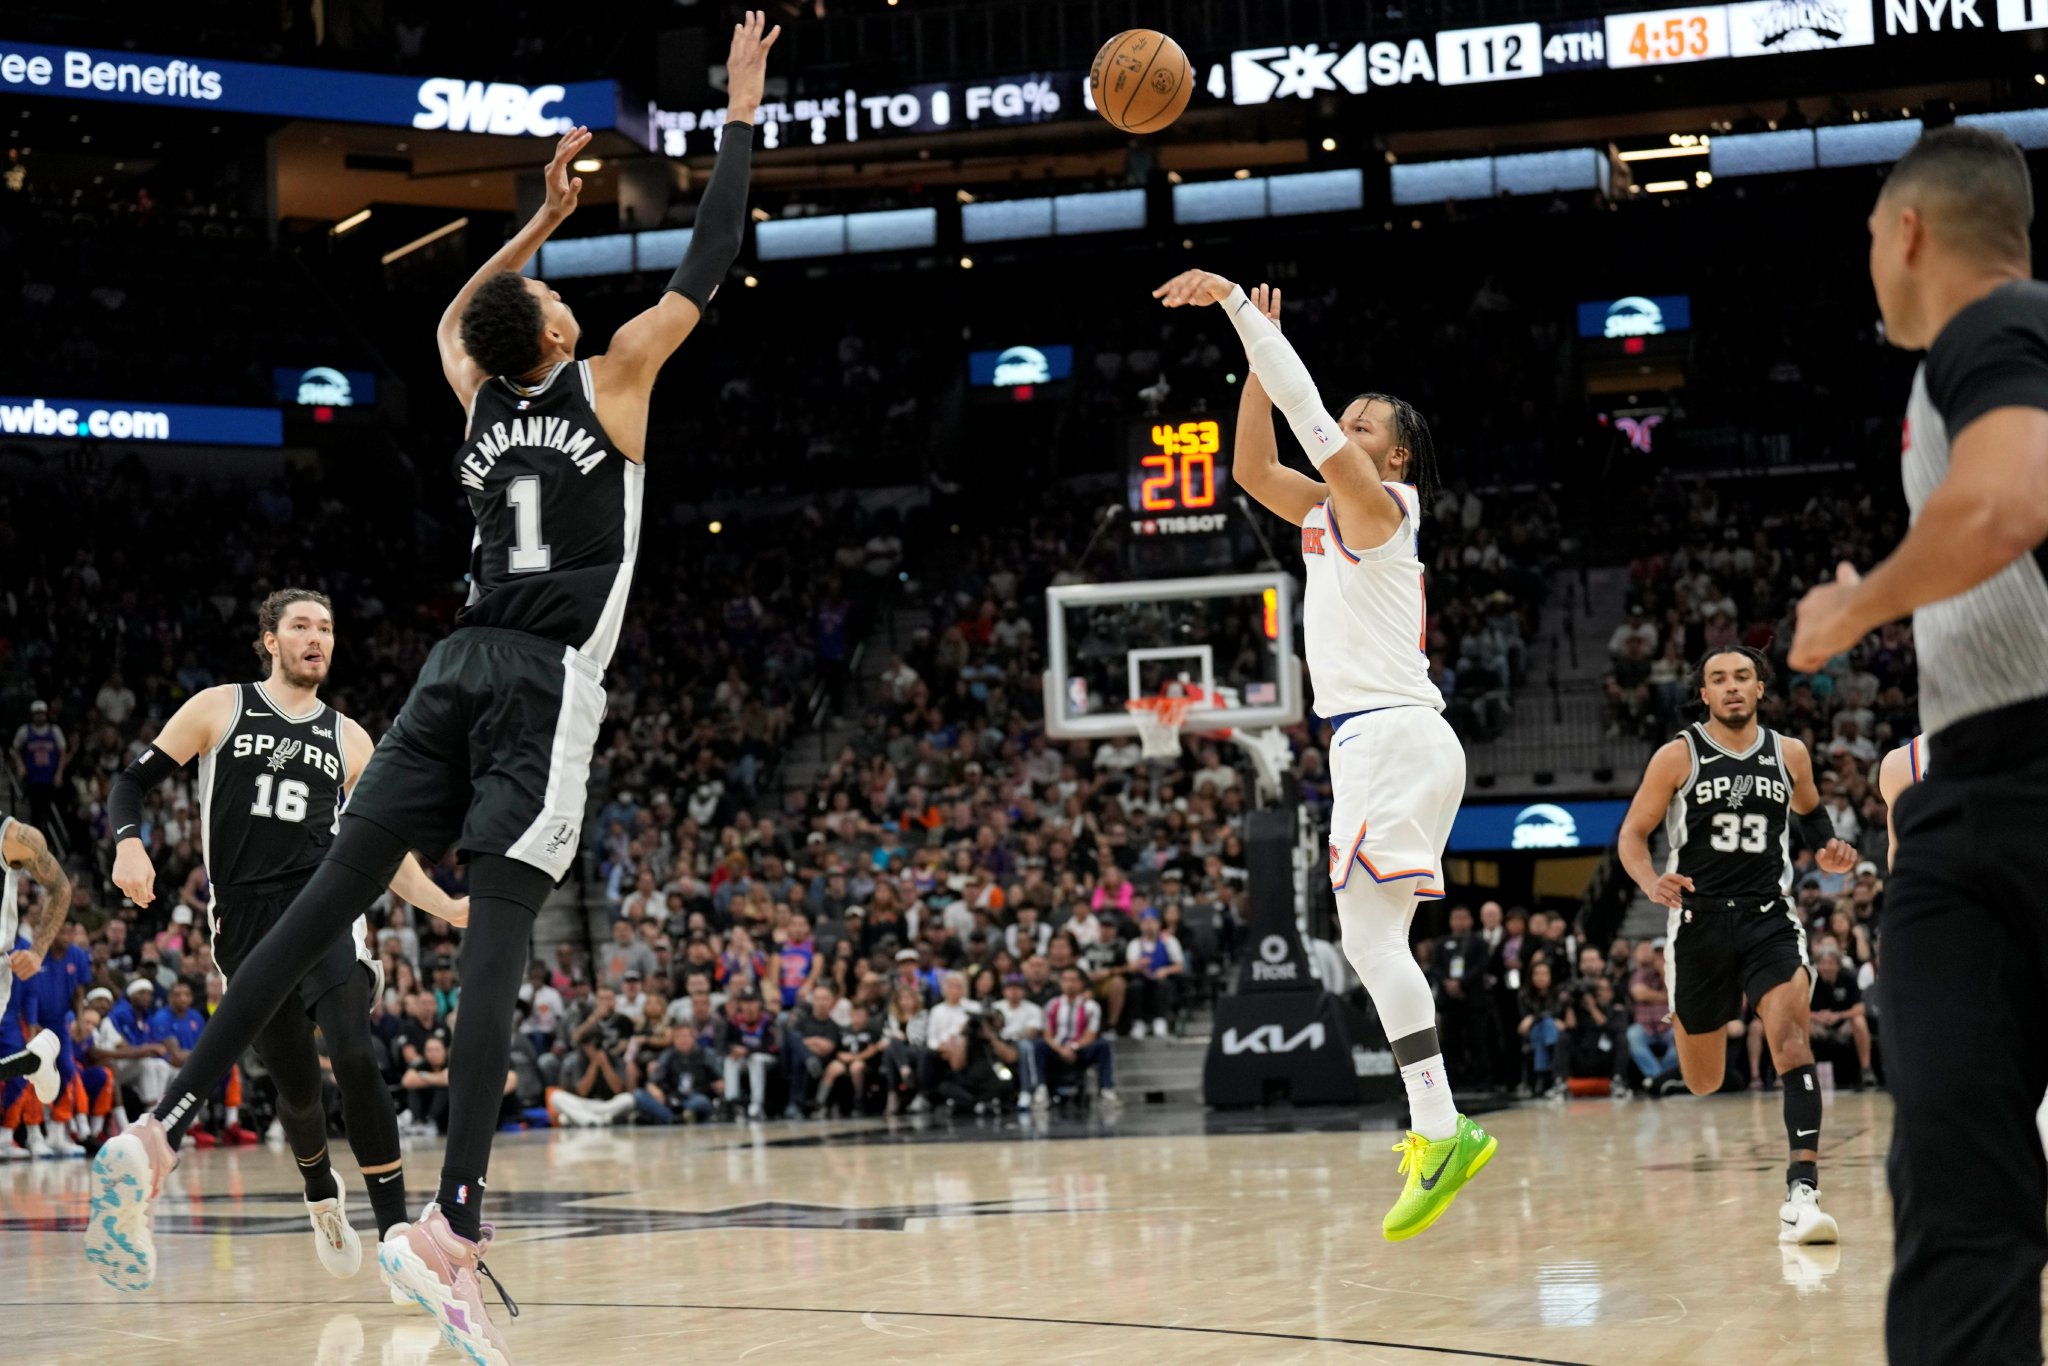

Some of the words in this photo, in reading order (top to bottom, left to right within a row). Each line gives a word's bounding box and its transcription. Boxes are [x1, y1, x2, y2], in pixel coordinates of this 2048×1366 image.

[1885, 0, 1985, 35] NYK
[0, 53, 53, 86] ee
[64, 50, 223, 101] Benefits
[1368, 38, 1435, 87] SA
[1461, 34, 1523, 77] 112
[1543, 30, 1605, 64] 4TH
[1629, 16, 1710, 62] 4:53
[412, 77, 566, 138] SWBC
[700, 107, 729, 131] AS
[794, 97, 842, 121] BLK
[861, 94, 921, 129] TO
[965, 79, 1061, 121] FG%
[0, 399, 169, 440] wbc.com
[1151, 421, 1219, 456] 4:53
[460, 416, 608, 491] WEMBANYAMA
[1141, 453, 1215, 511] 20
[506, 475, 551, 574] 1
[1157, 514, 1227, 535] TISSOT
[233, 733, 340, 781] SPURS
[250, 772, 310, 823] 16
[1695, 775, 1786, 809] SPURS
[1710, 812, 1769, 854] 33
[1222, 1021, 1326, 1055] KIA
